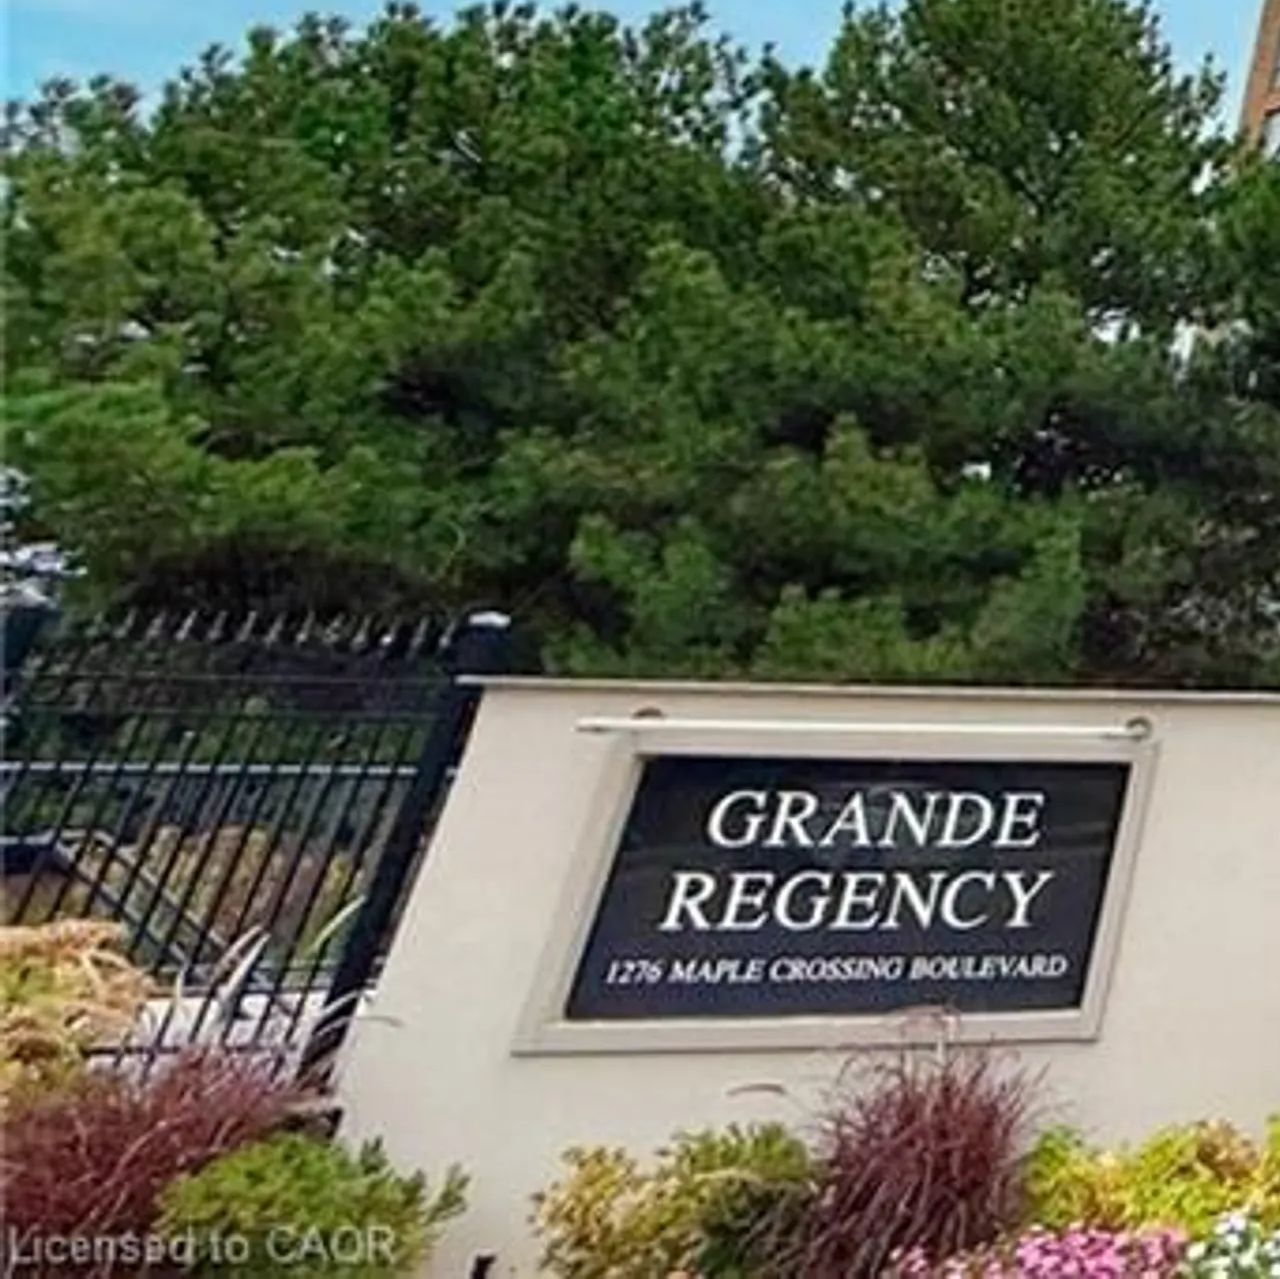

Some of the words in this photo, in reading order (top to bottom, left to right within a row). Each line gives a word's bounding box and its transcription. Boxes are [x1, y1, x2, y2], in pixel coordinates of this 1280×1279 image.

[708, 790, 1044, 848] GRANDE
[659, 870, 1055, 931] REGENCY
[605, 959, 663, 985] 1276
[667, 958, 765, 983] MAPLE
[768, 956, 903, 981] CROSSING
[909, 953, 1068, 980] BOULEVARD
